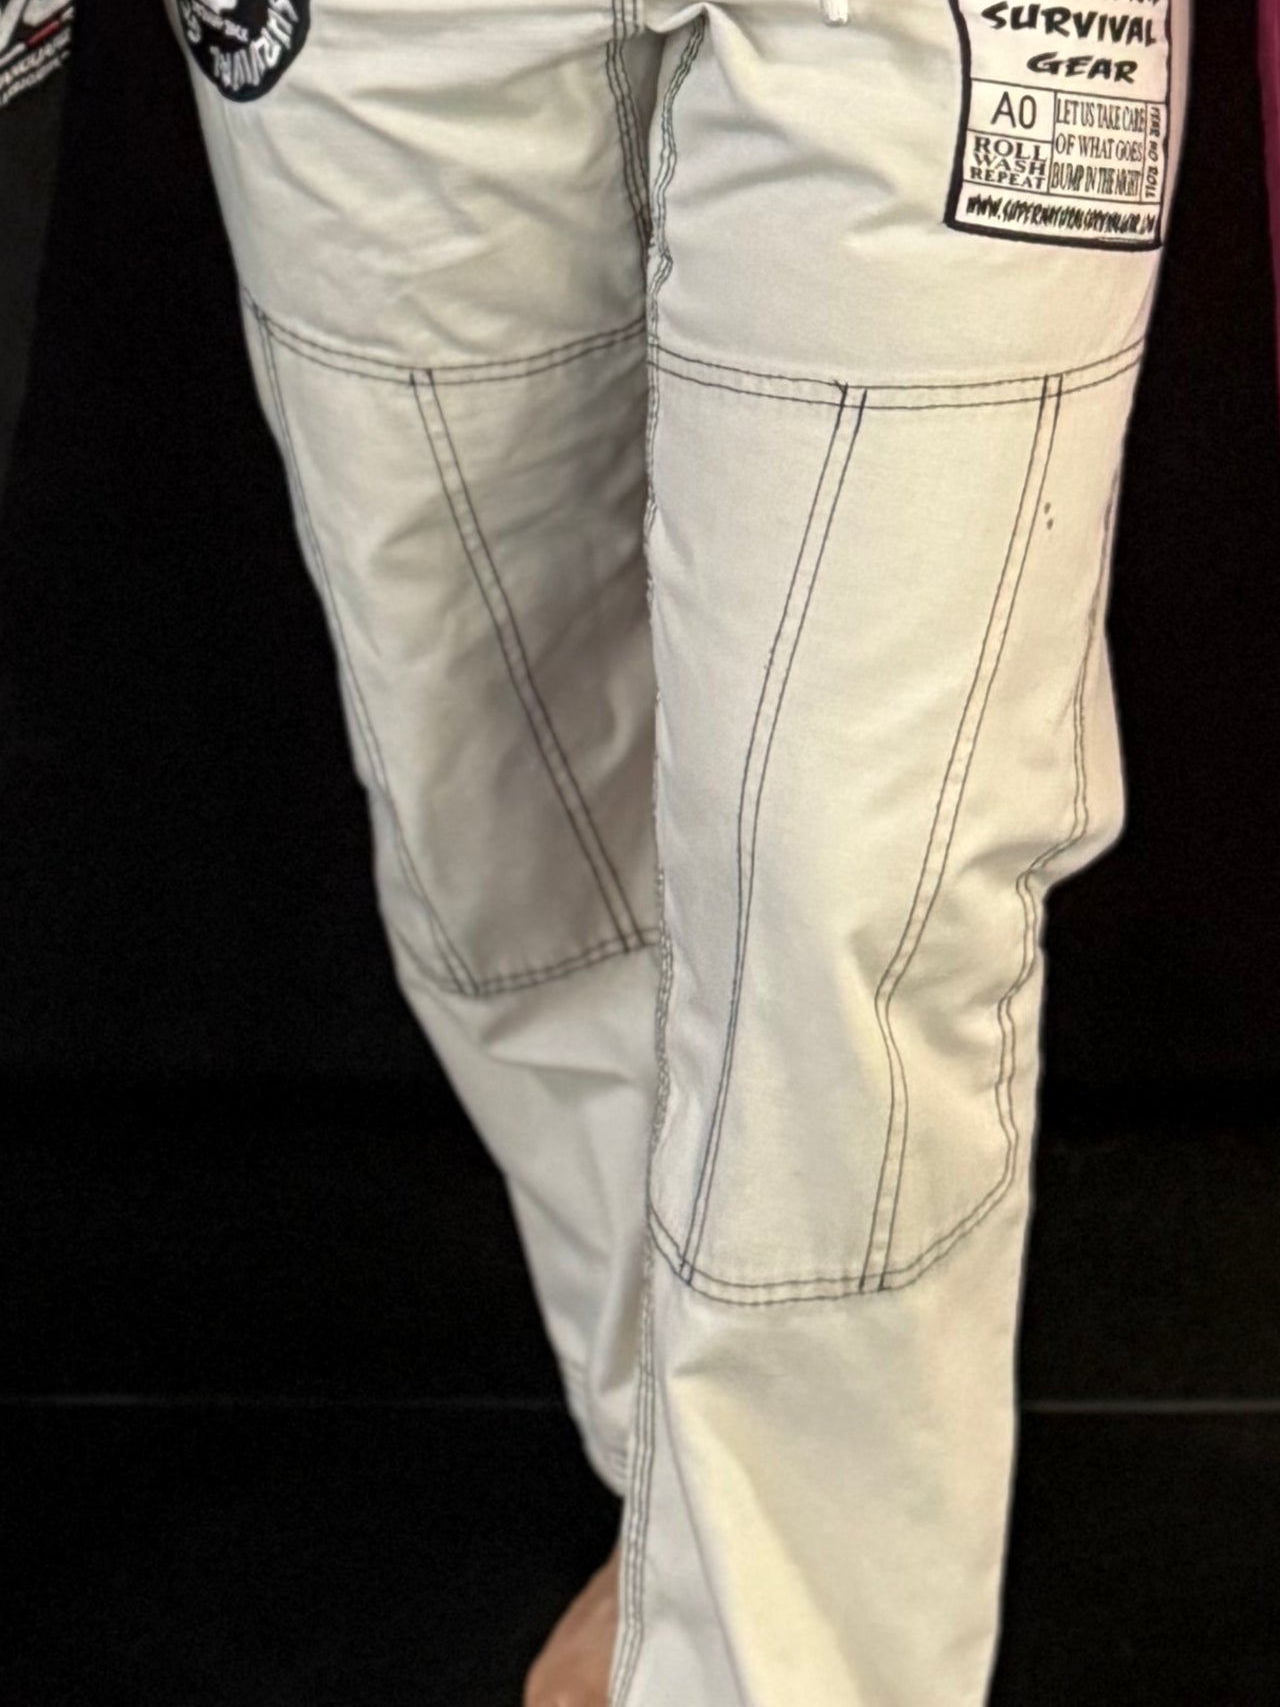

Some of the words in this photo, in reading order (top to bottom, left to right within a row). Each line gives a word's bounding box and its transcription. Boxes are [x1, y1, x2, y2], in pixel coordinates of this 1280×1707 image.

[981, 0, 1157, 48] SURVIVAL
[1026, 51, 1139, 85] GEAR
[1056, 98, 1080, 126] LET
[1080, 100, 1096, 128] US
[1096, 103, 1122, 131] TAKE
[973, 135, 1048, 163] ROLL
[1055, 132, 1076, 155] OF
[1077, 134, 1115, 160] WHAT
[1115, 139, 1143, 163] GOES
[969, 166, 1046, 190] REPEAT
[973, 152, 1046, 177] WASH
[1050, 161, 1085, 192] BUMP
